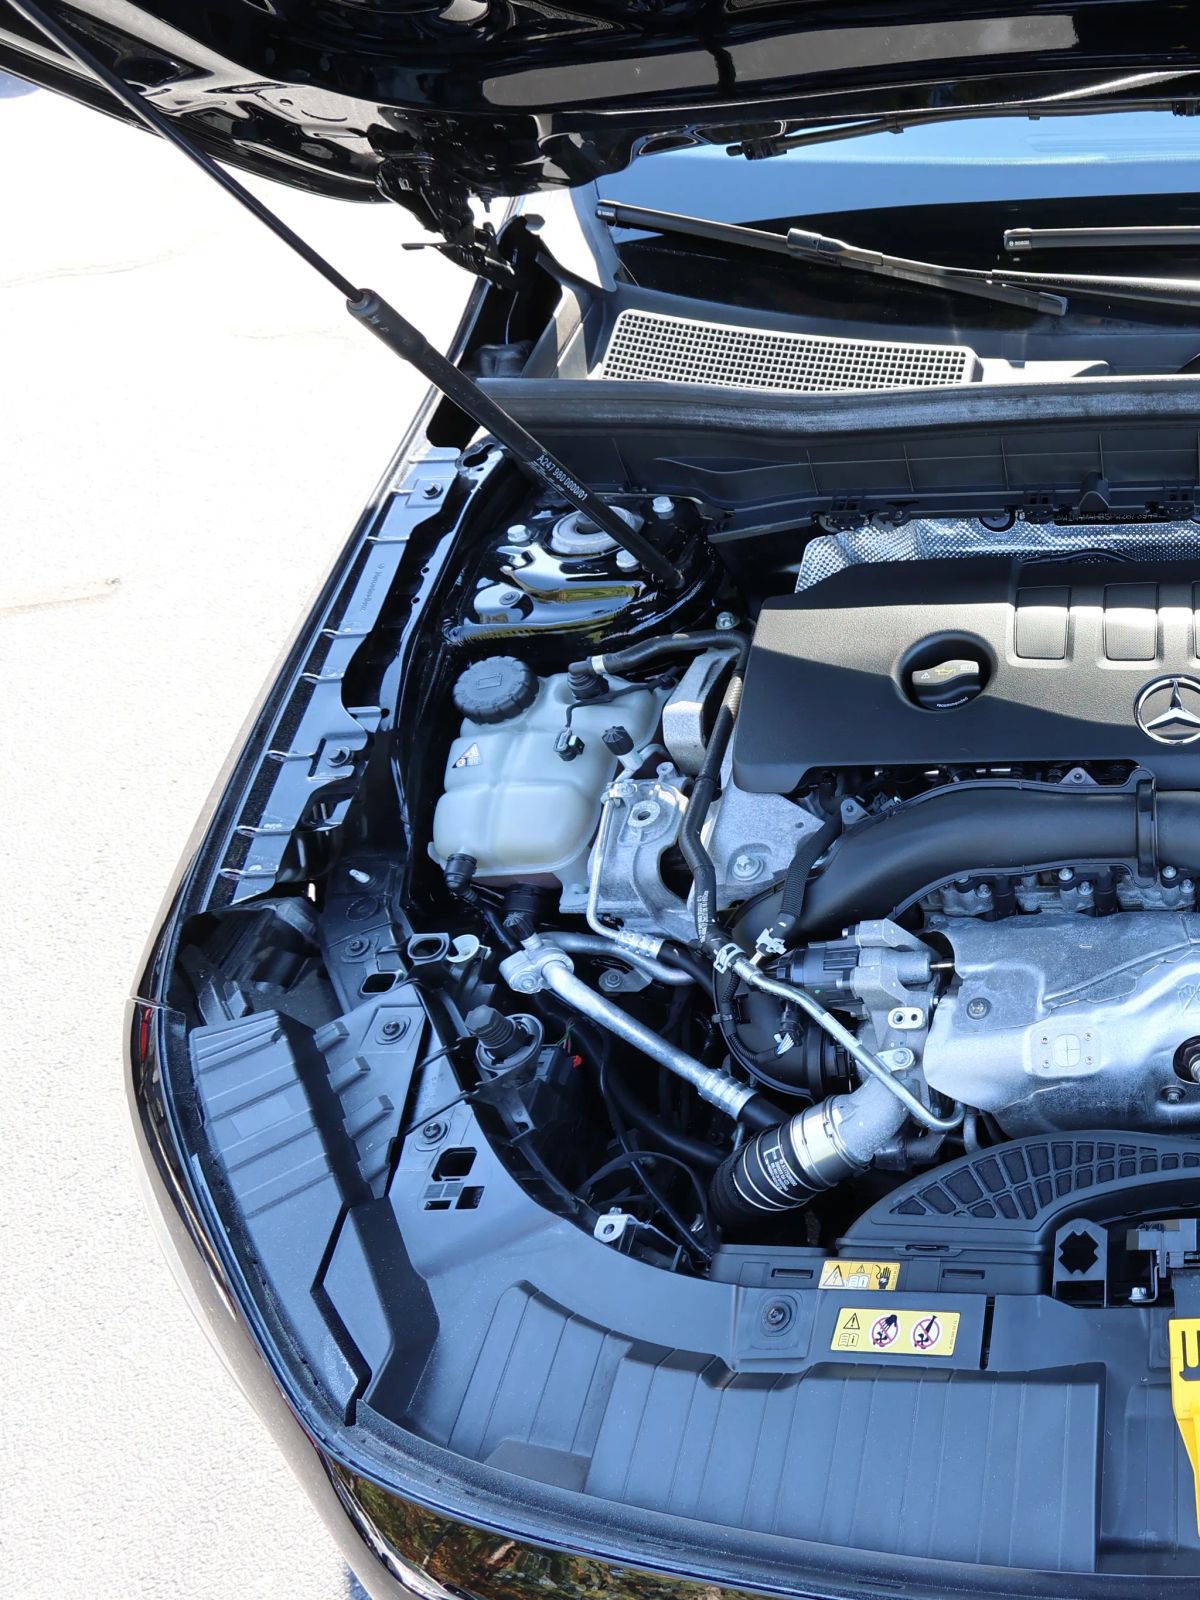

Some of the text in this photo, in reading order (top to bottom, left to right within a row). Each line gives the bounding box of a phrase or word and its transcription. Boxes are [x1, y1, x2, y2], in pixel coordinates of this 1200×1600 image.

[537, 454, 556, 472] A247
[552, 468, 567, 482] 980
[563, 477, 588, 501] 0000/01
